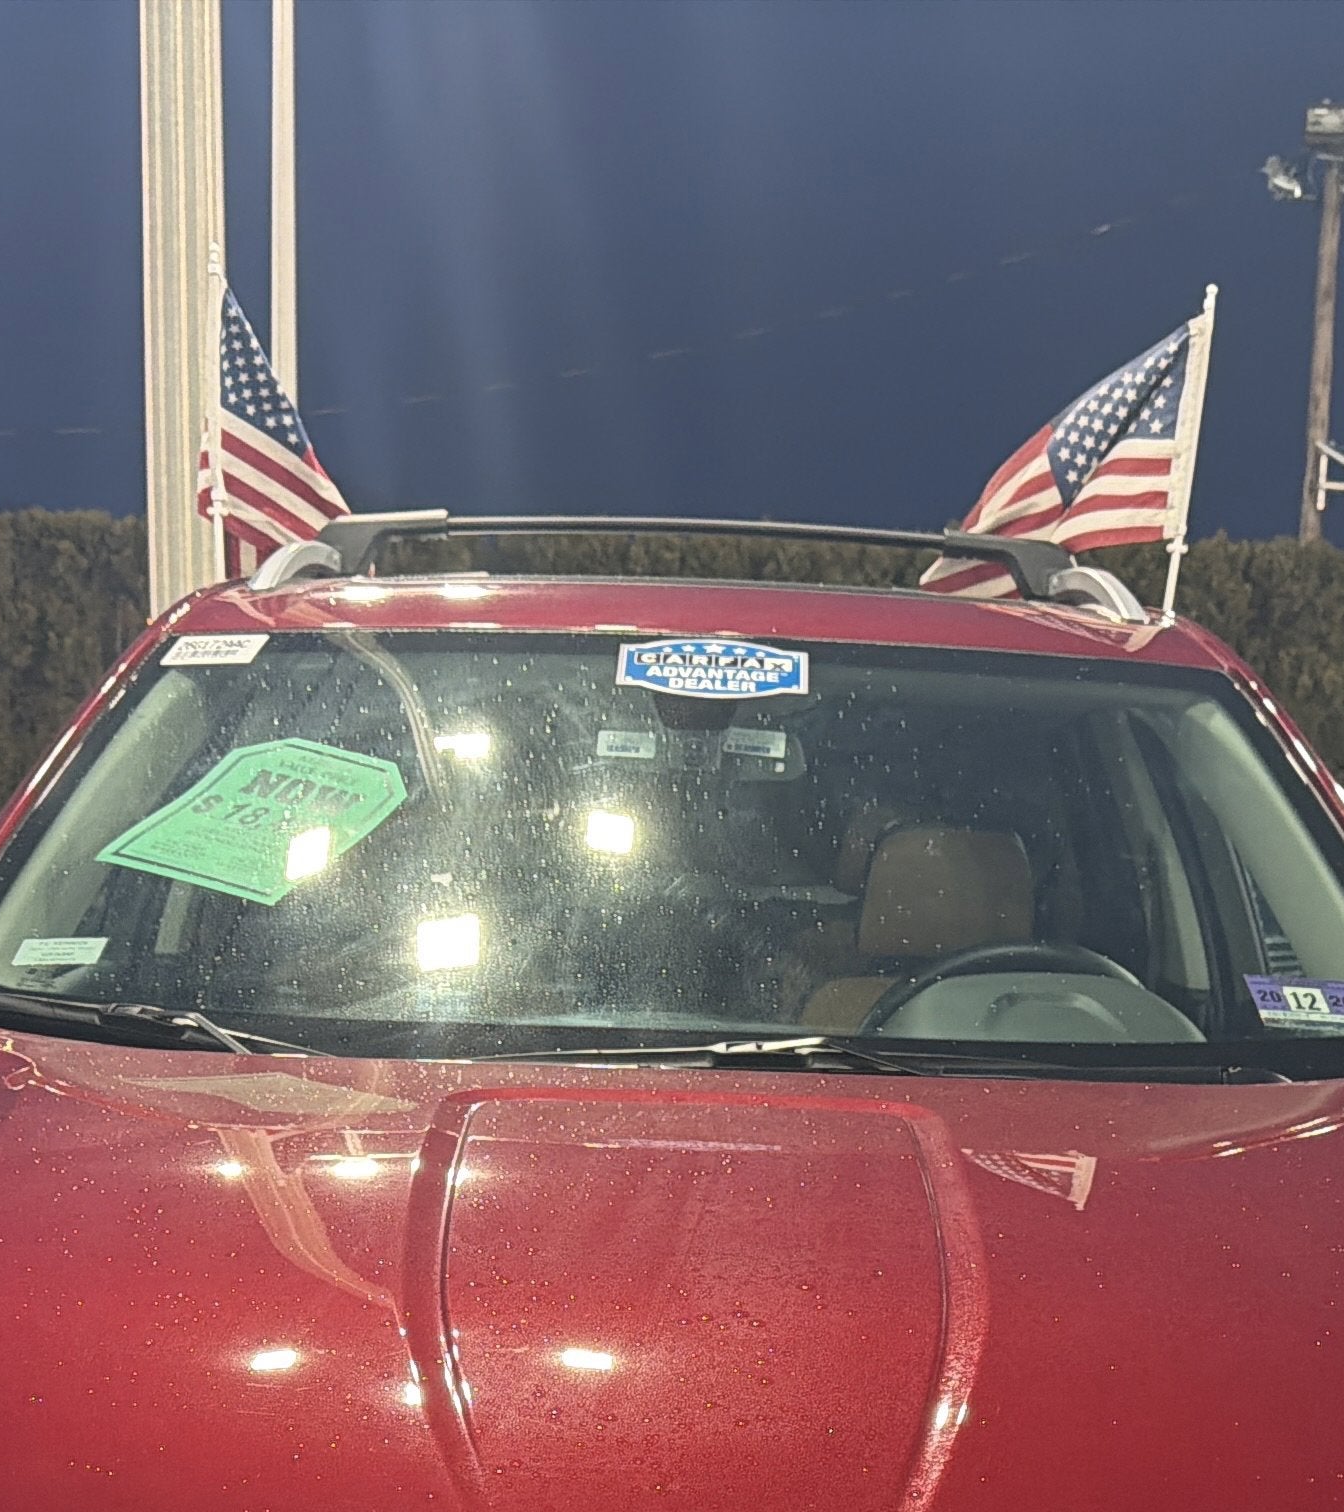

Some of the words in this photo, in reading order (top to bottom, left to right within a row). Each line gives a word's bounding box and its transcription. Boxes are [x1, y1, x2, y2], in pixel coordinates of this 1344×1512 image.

[638, 652, 789, 673] CARFAX
[646, 666, 780, 683] ADVANTAGE
[668, 677, 756, 693] DEALER
[239, 769, 366, 815] NOW
[1256, 988, 1283, 1003] 20
[1289, 991, 1322, 1012] 12
